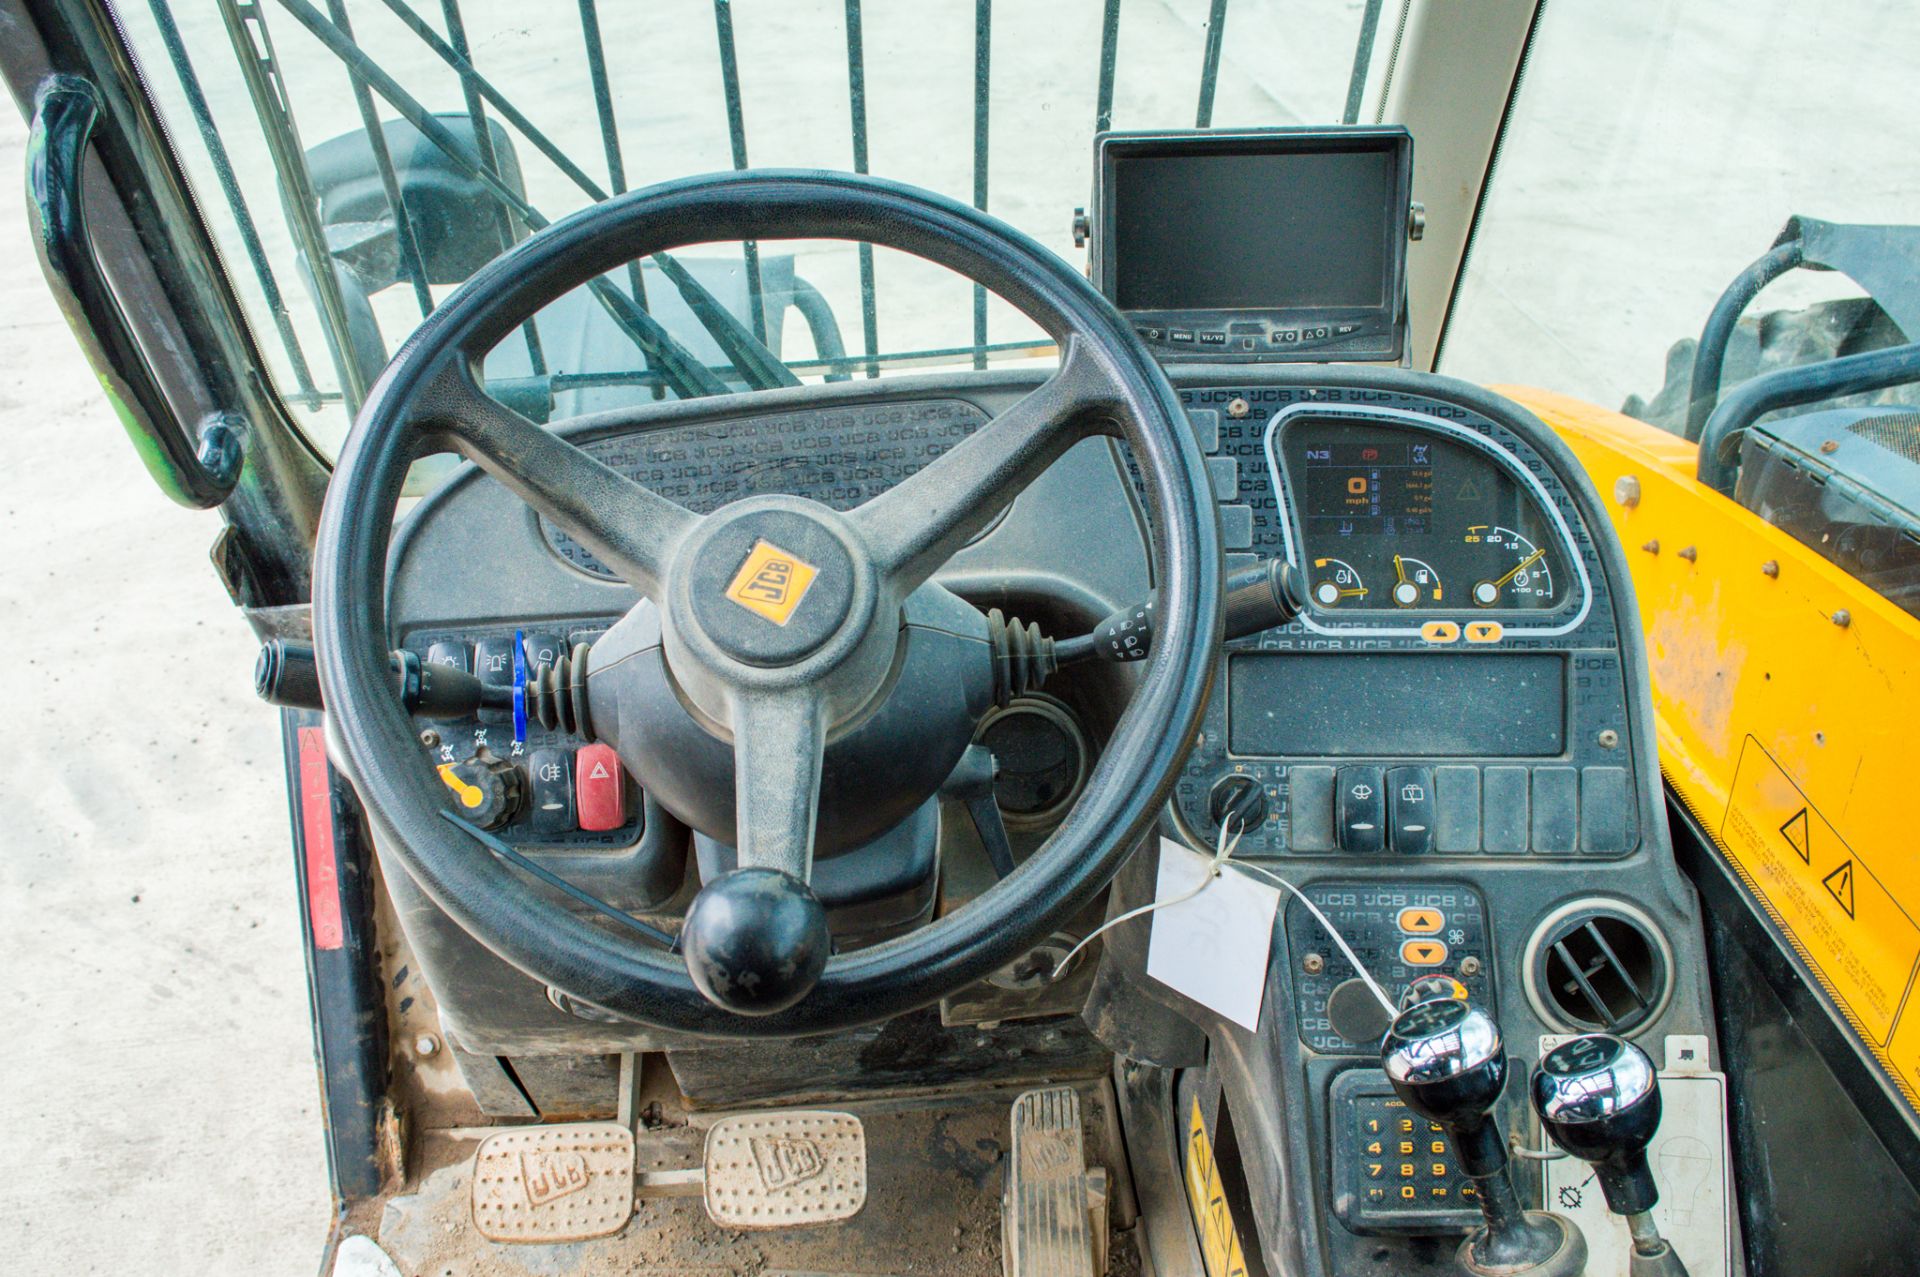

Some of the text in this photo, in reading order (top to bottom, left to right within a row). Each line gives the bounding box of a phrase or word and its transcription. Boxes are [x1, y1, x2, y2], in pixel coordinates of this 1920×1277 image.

[1250, 390, 1292, 401] JCB
[1349, 389, 1392, 400] JCB
[1307, 450, 1329, 460] N3
[1348, 477, 1367, 494] 0
[1504, 542, 1518, 550] 15
[1532, 570, 1540, 578] 5
[748, 562, 790, 600] JCB
[1536, 589, 1544, 597] 0
[1314, 894, 1357, 905] JCB
[1363, 894, 1407, 906] JCB
[1415, 895, 1457, 907] JCB
[1369, 1120, 1378, 1131] 1
[1401, 1119, 1413, 1131] 2
[1368, 1141, 1445, 1154] 4 5 6
[1369, 1163, 1446, 1176] 7 8 9
[1401, 1186, 1415, 1198] 0
[1432, 1188, 1447, 1196] F2
